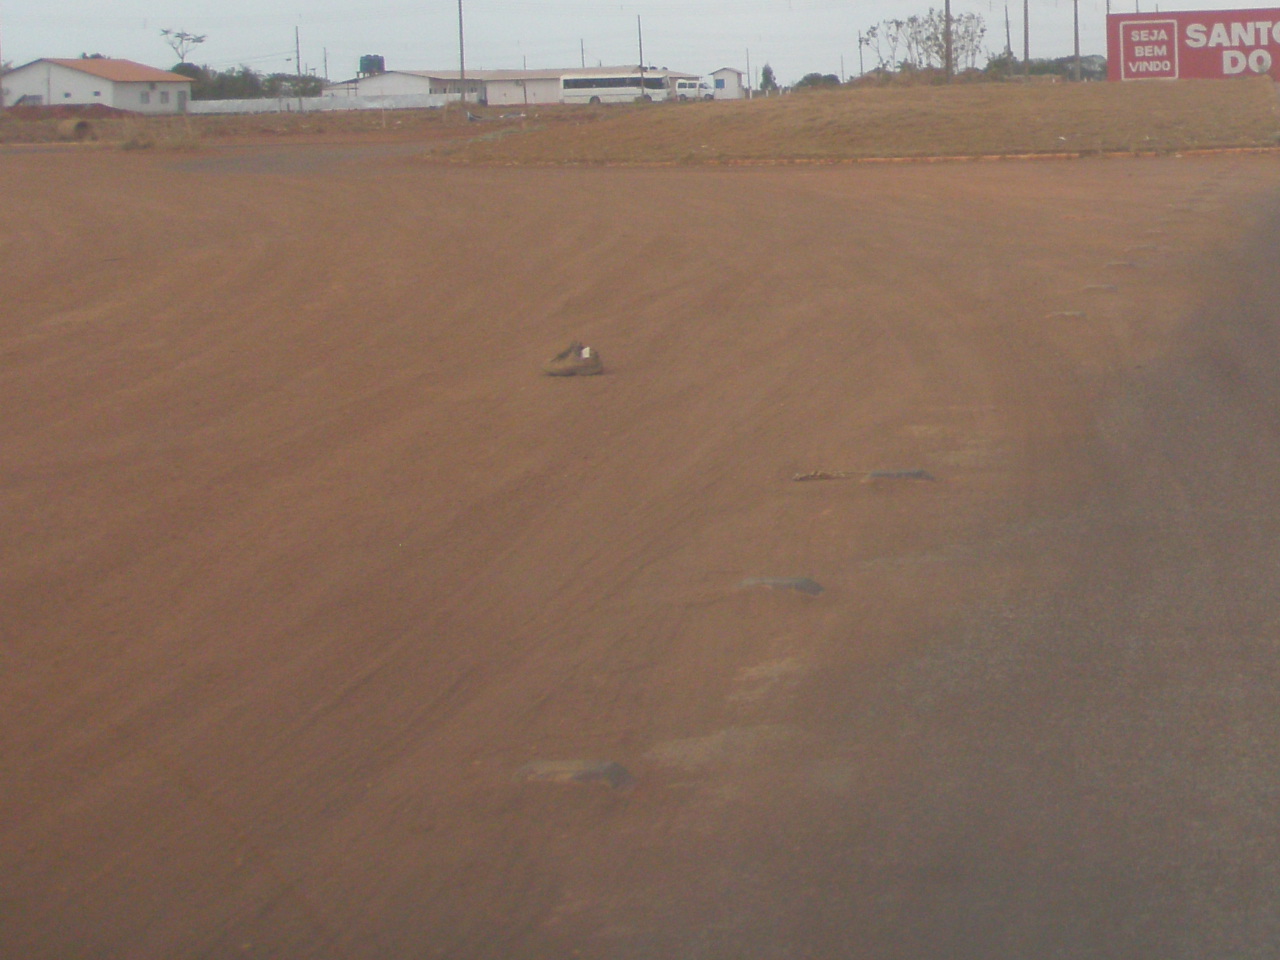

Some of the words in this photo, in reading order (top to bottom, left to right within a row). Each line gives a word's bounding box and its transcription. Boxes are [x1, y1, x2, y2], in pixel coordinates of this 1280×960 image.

[1131, 29, 1168, 42] SEJA
[1134, 44, 1167, 57] BEM
[1128, 60, 1171, 73] VINDO
[1223, 49, 1272, 75] DO
